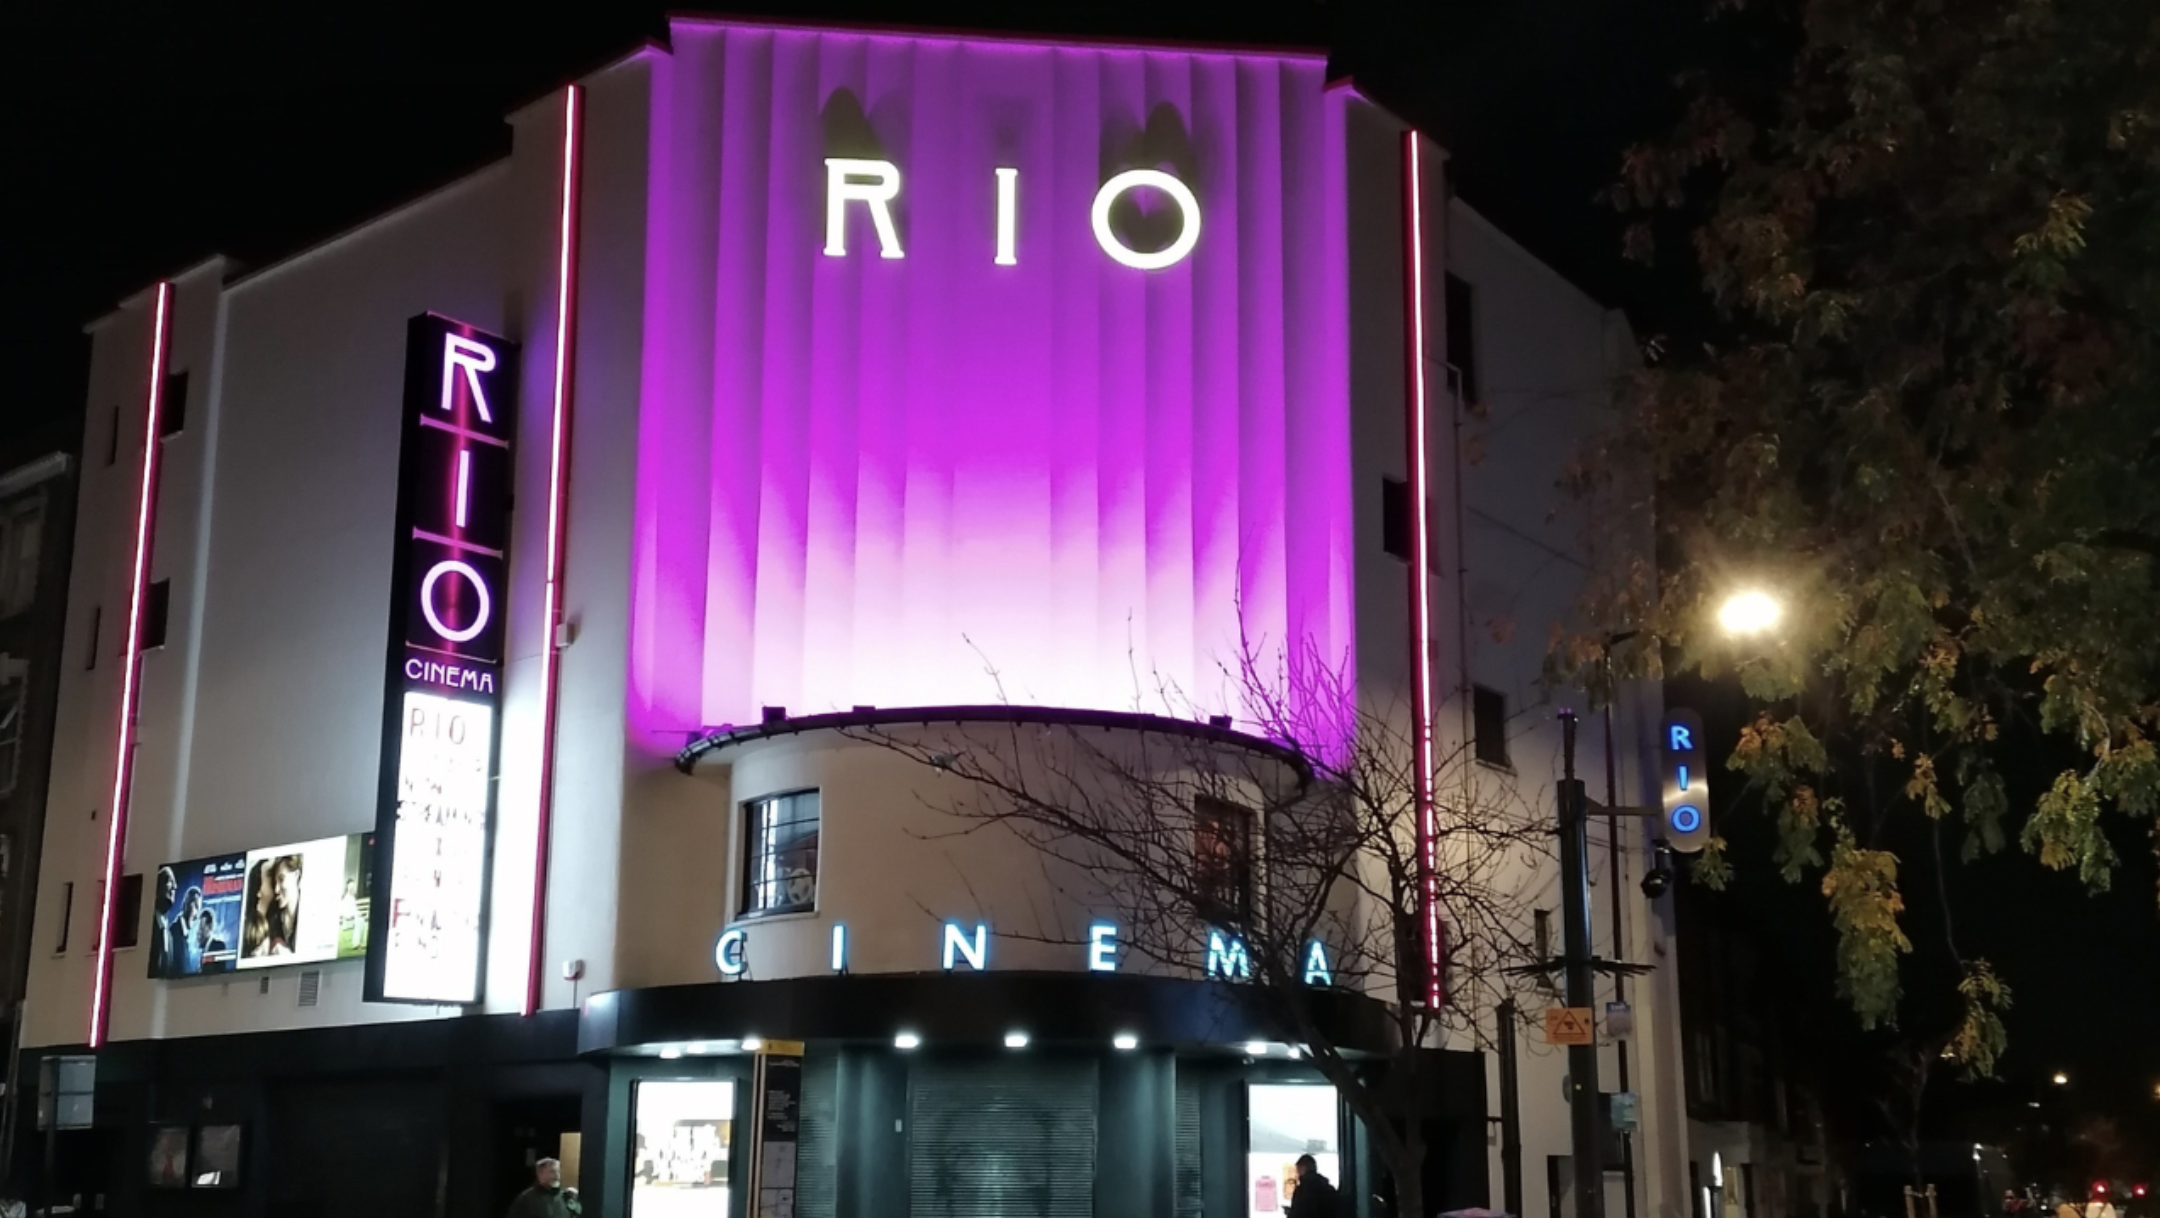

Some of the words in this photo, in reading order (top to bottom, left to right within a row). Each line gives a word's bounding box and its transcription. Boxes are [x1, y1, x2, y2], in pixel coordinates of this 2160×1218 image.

[823, 158, 1201, 269] RIO
[420, 332, 497, 642] RIO
[404, 658, 494, 694] CINEMA
[410, 707, 466, 745] RIO
[1670, 725, 1701, 833] RIO
[715, 923, 1332, 986] CINEMA
